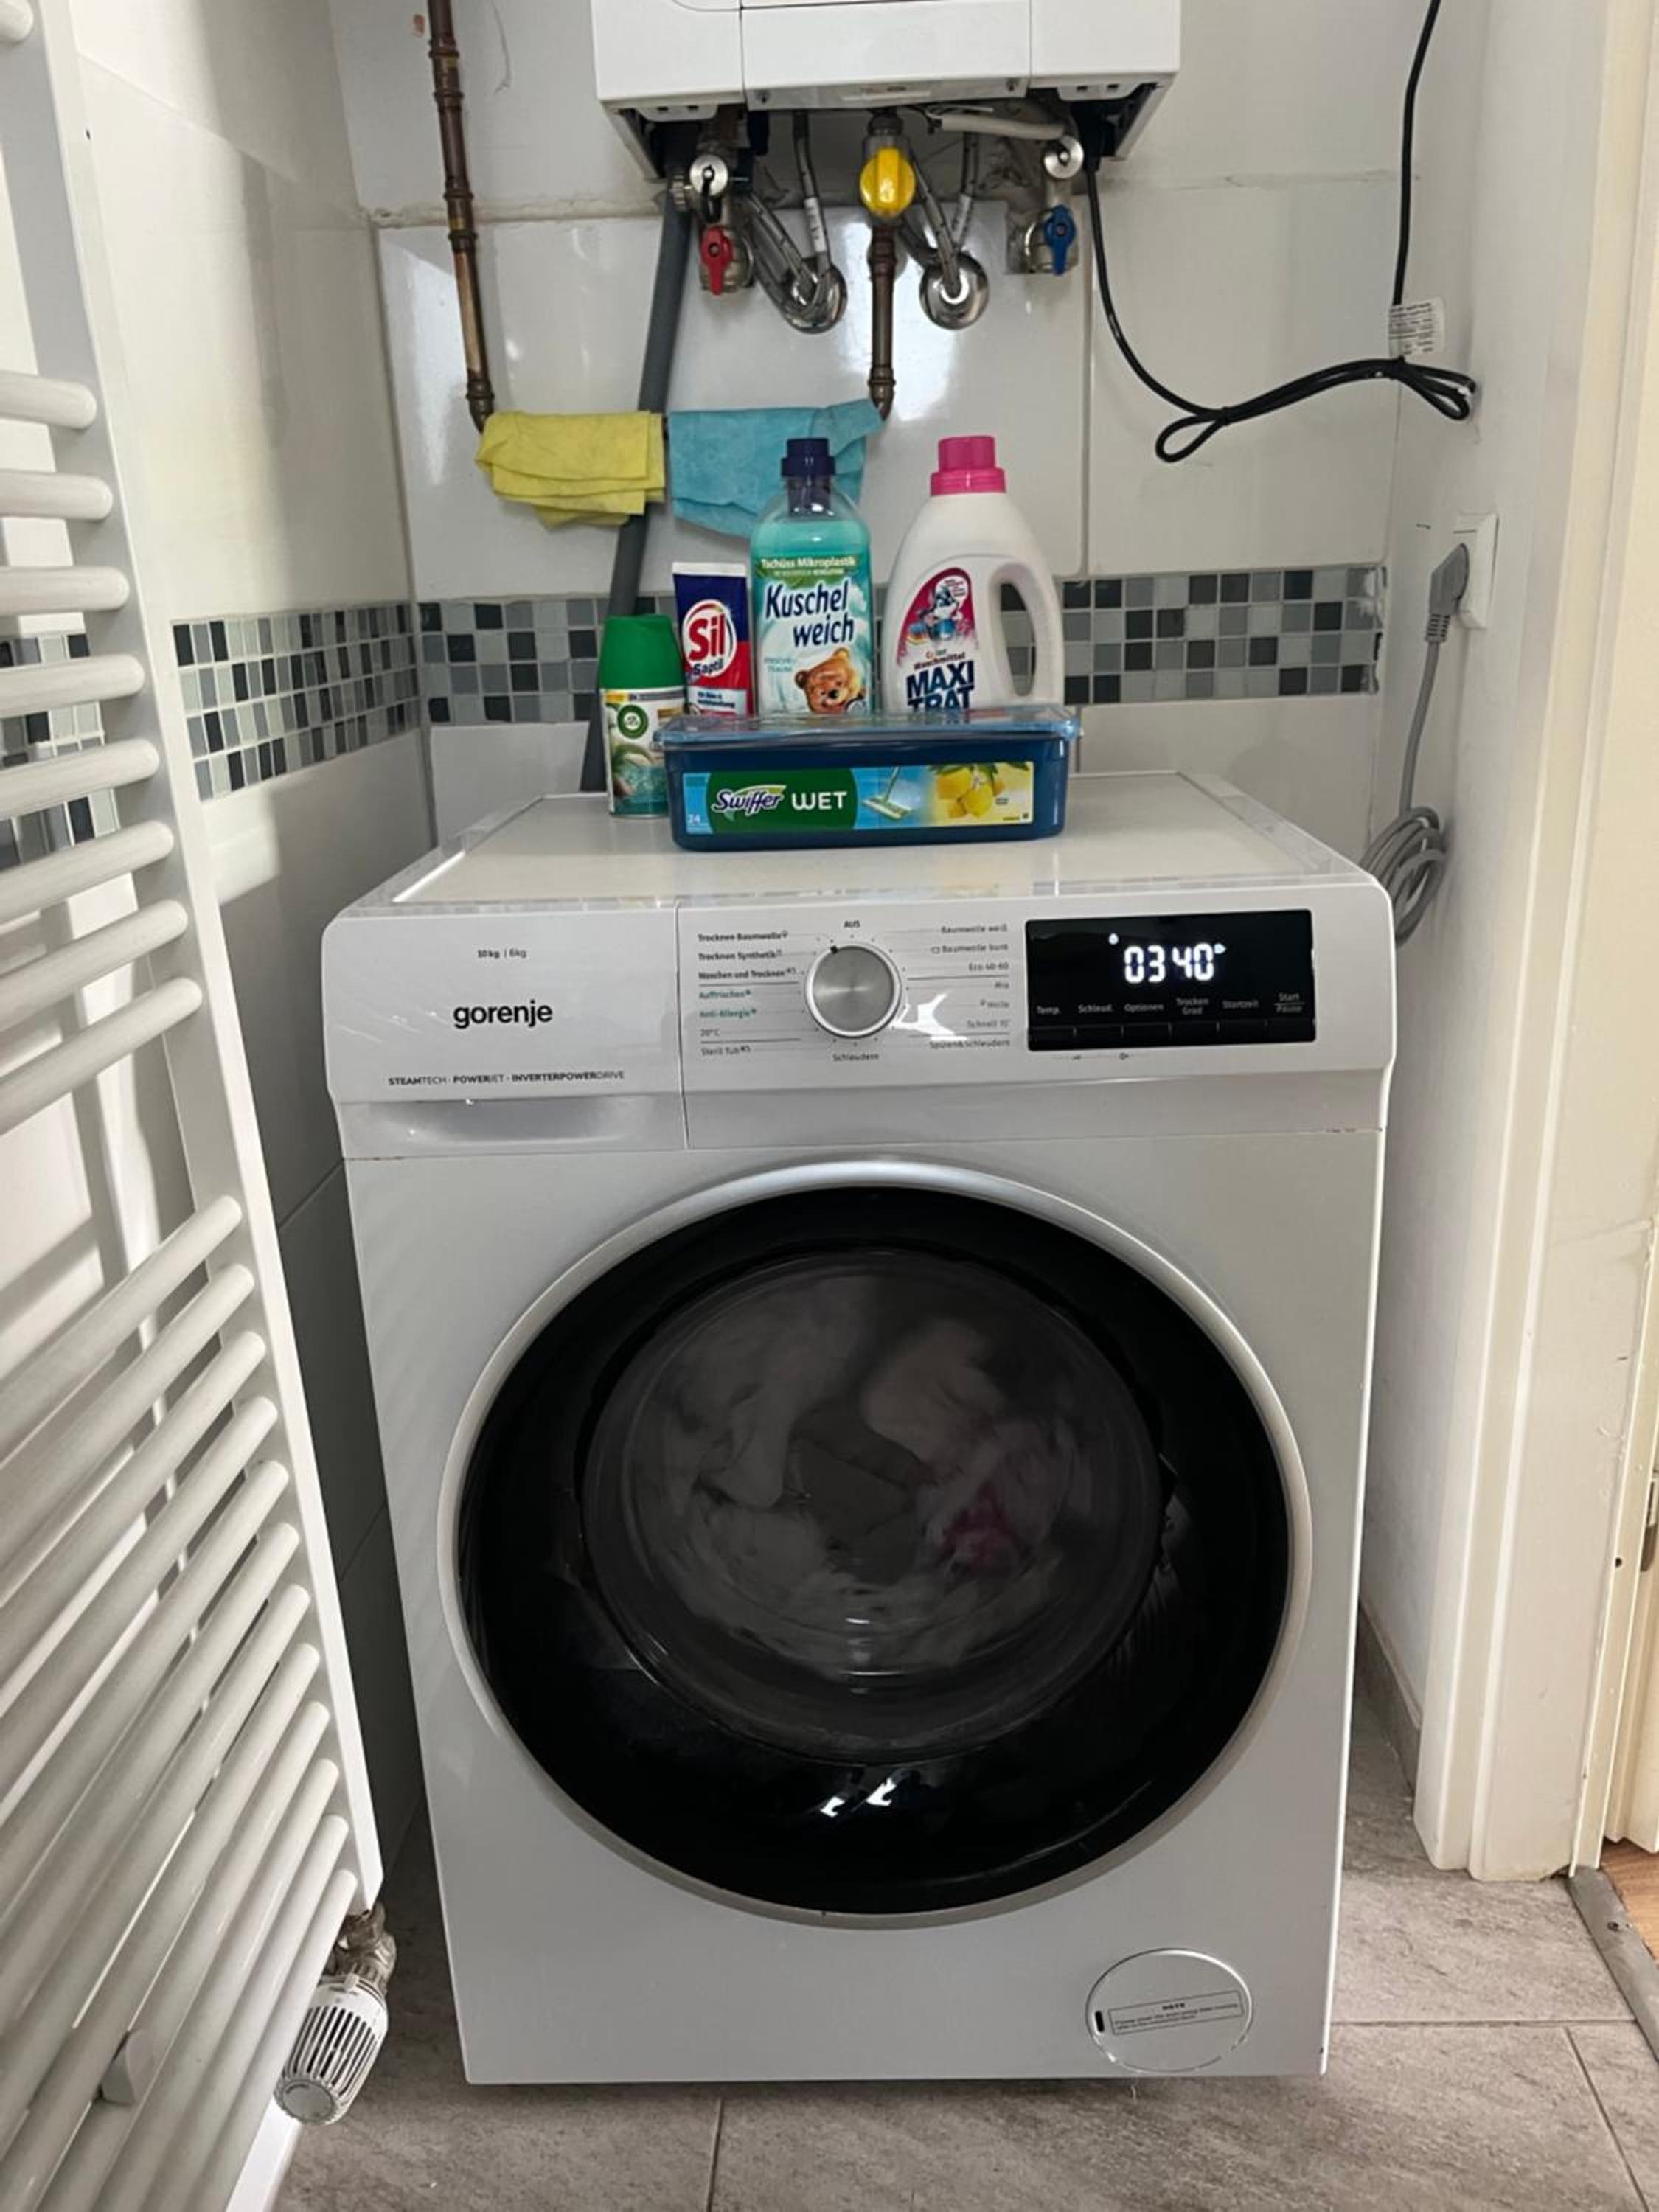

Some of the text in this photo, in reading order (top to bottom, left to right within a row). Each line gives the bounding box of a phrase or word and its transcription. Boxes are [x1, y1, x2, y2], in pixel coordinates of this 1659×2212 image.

[797, 557, 856, 568] Mikroplastik
[765, 578, 849, 618] Kuschel
[689, 613, 726, 661] Sil
[793, 616, 854, 647] weich
[906, 661, 974, 699] MAXI
[712, 789, 847, 815] Swiffer WET
[844, 919, 860, 928] AUS
[698, 931, 780, 942] Trocknen Baumwolle
[698, 952, 735, 961] Trocknen
[698, 968, 785, 979] Waschen und Trocknen
[1279, 992, 1300, 1001] Start
[453, 999, 553, 1029] gorenje
[1124, 1004, 1164, 1013] Optionen
